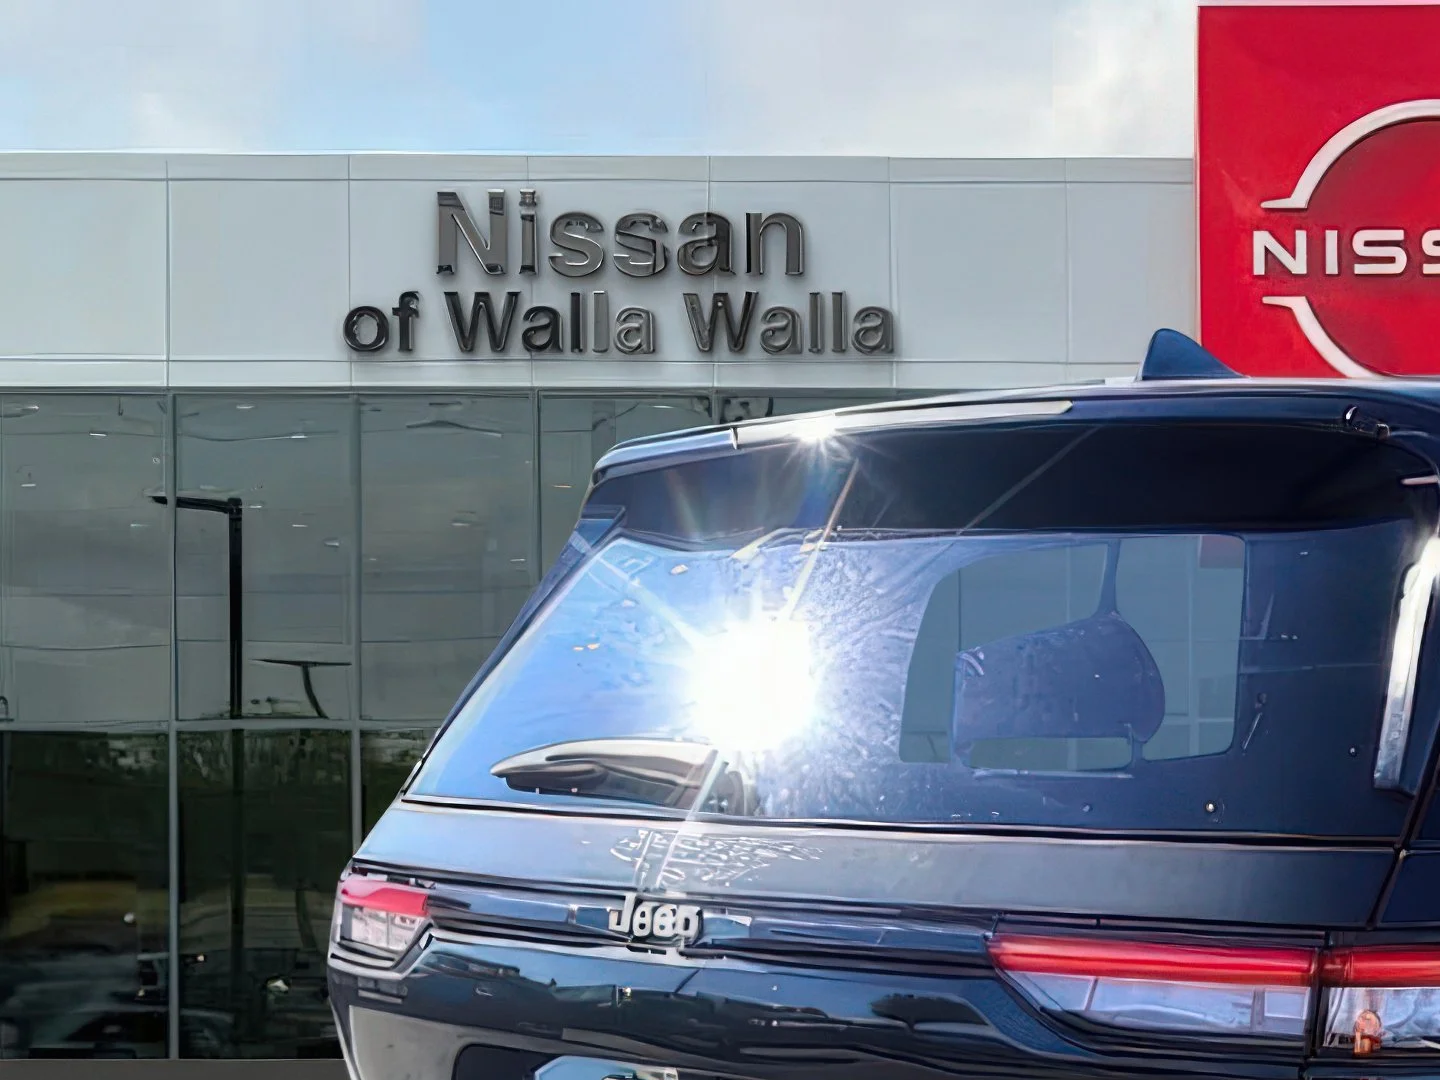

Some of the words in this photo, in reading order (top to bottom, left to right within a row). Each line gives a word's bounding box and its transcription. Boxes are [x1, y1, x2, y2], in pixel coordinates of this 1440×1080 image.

[436, 189, 805, 278] Nissan
[342, 291, 419, 353] of
[444, 291, 656, 354] Walla
[682, 291, 895, 354] Walla
[608, 893, 703, 948] Jeep
